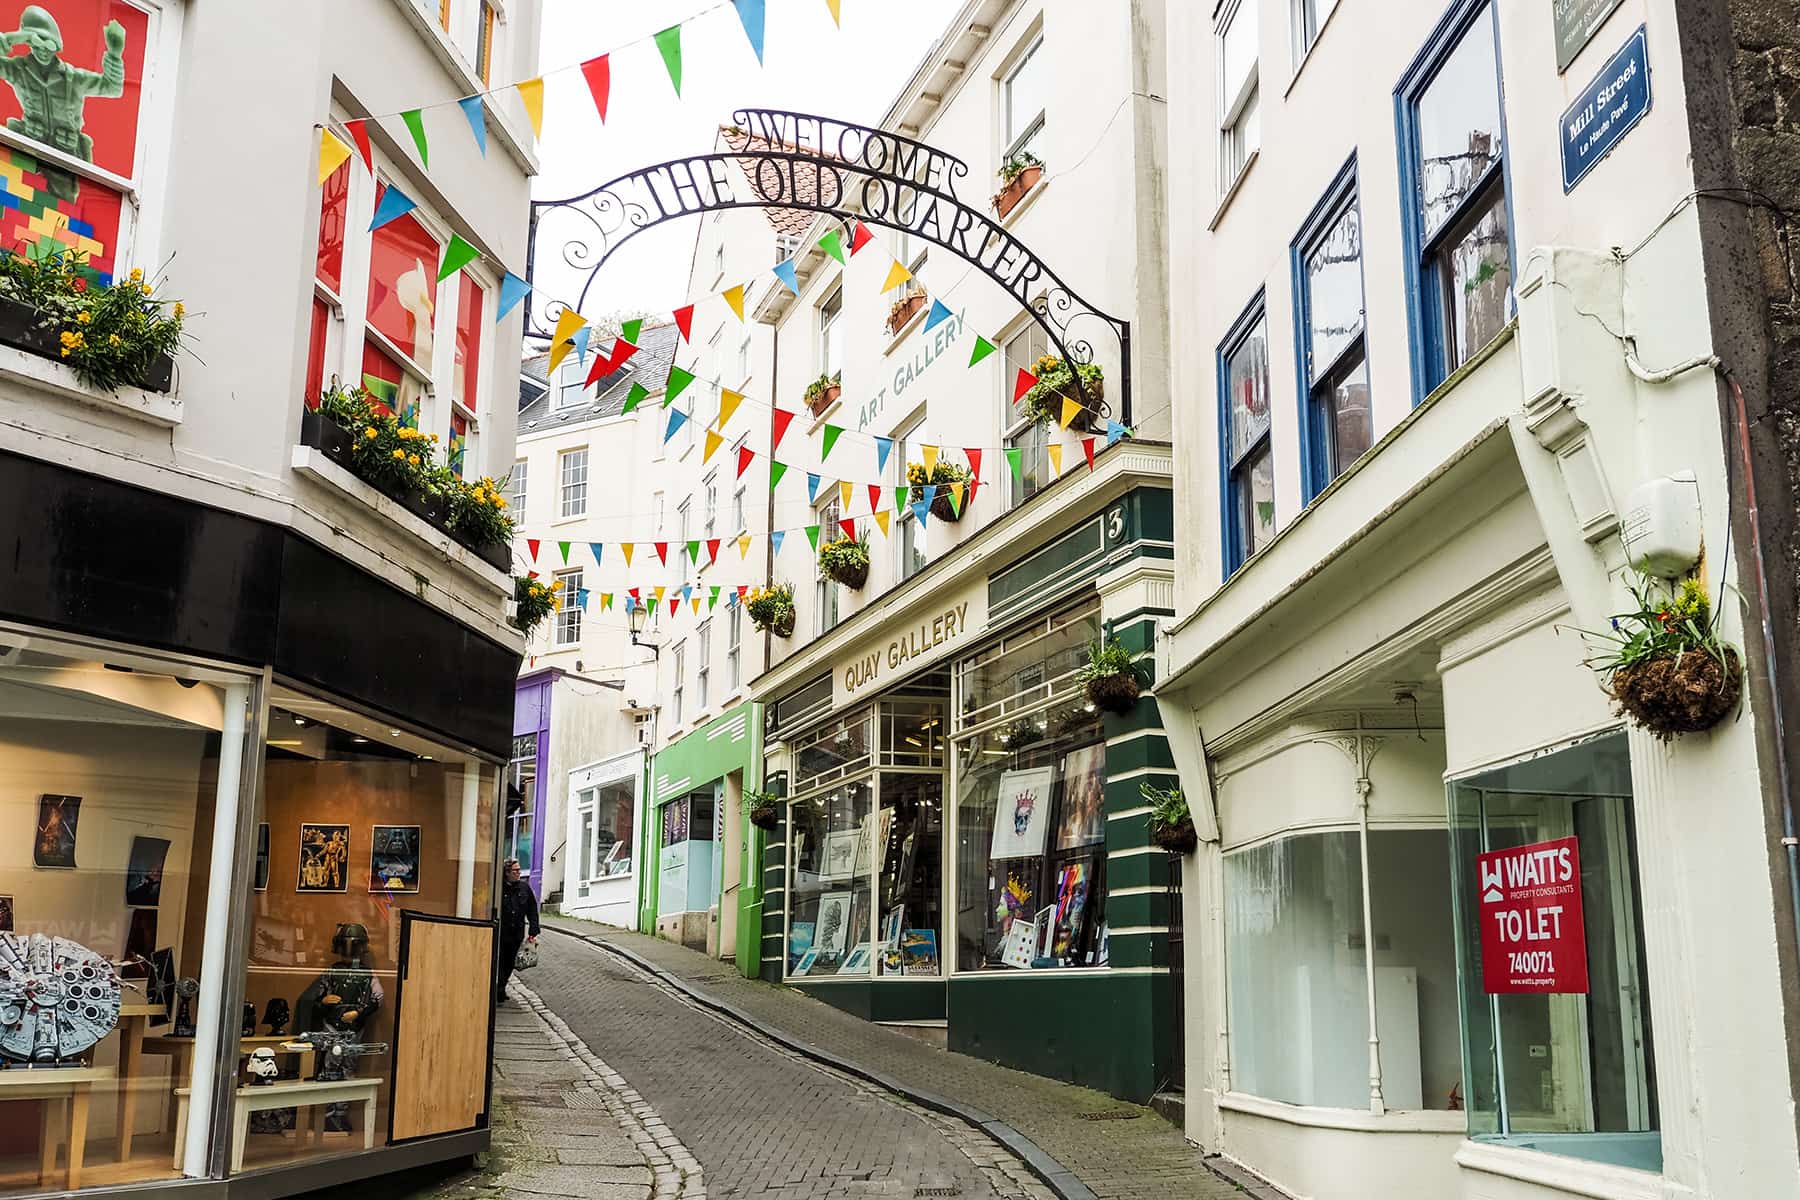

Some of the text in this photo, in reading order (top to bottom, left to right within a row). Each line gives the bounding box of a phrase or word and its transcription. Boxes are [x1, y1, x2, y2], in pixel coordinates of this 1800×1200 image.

[1569, 57, 1637, 143] Mill Street
[1590, 121, 1610, 147] Haute
[1610, 94, 1629, 124] Pavé
[755, 111, 946, 191] WELCOME
[630, 157, 1042, 305] THE OLD QUARTER
[858, 307, 965, 432] ART GALLERY
[1108, 507, 1123, 539] 3
[845, 601, 968, 693] QUAY GALLERY
[1505, 847, 1573, 888] WATTS
[1510, 884, 1574, 900] PROPERTY CONSULTANTS
[1494, 905, 1563, 942] TO LET
[1508, 951, 1555, 974] 740071
[1510, 977, 1555, 986] www.watts.property
